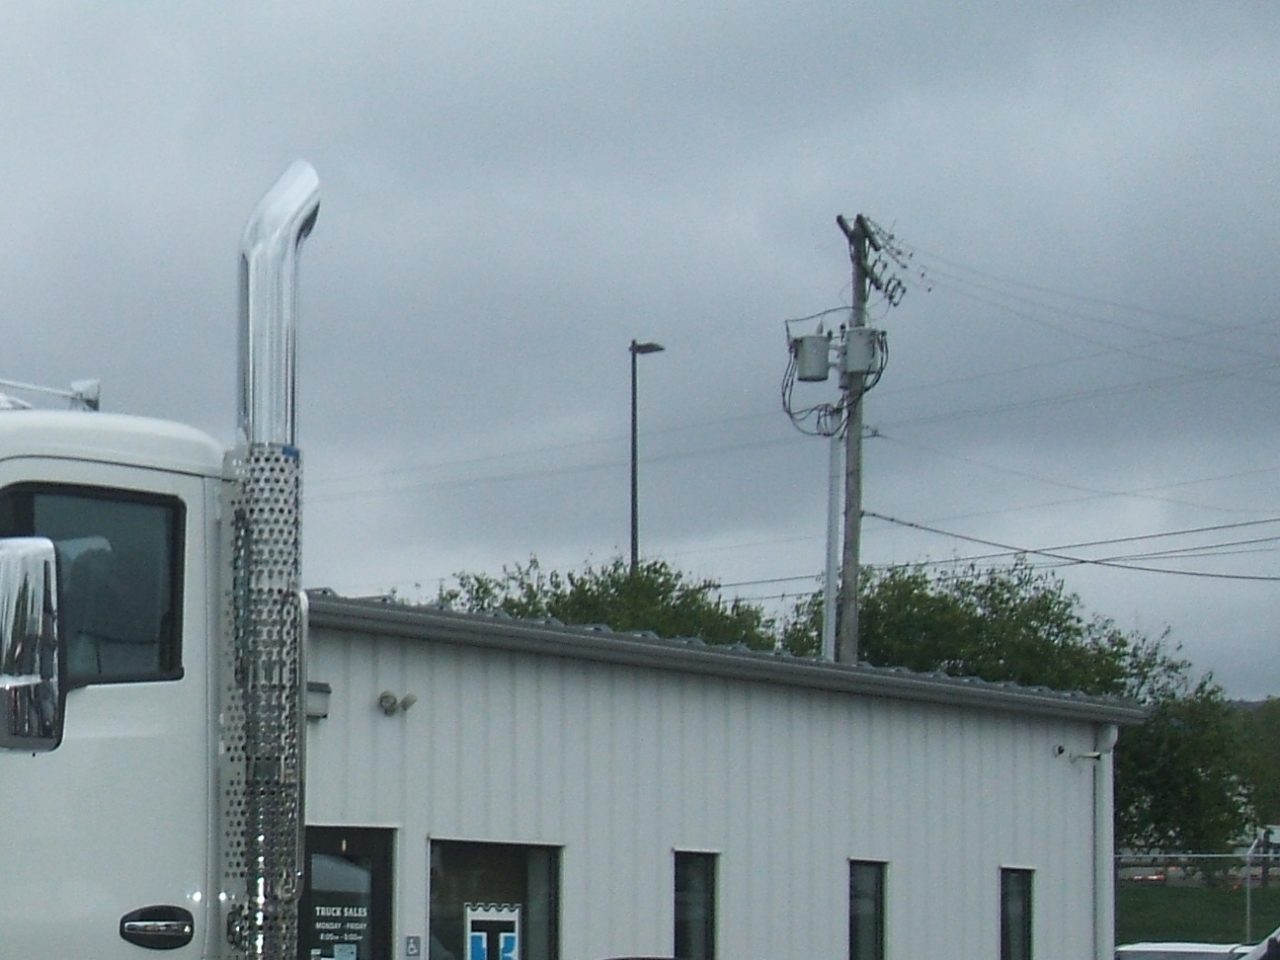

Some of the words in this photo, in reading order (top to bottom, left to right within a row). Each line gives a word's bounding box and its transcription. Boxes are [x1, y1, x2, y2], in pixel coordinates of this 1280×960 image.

[315, 906, 341, 917] TRUCK
[343, 906, 368, 917] SALES
[314, 921, 341, 930] MONDAY
[346, 922, 368, 930] FRIDAY
